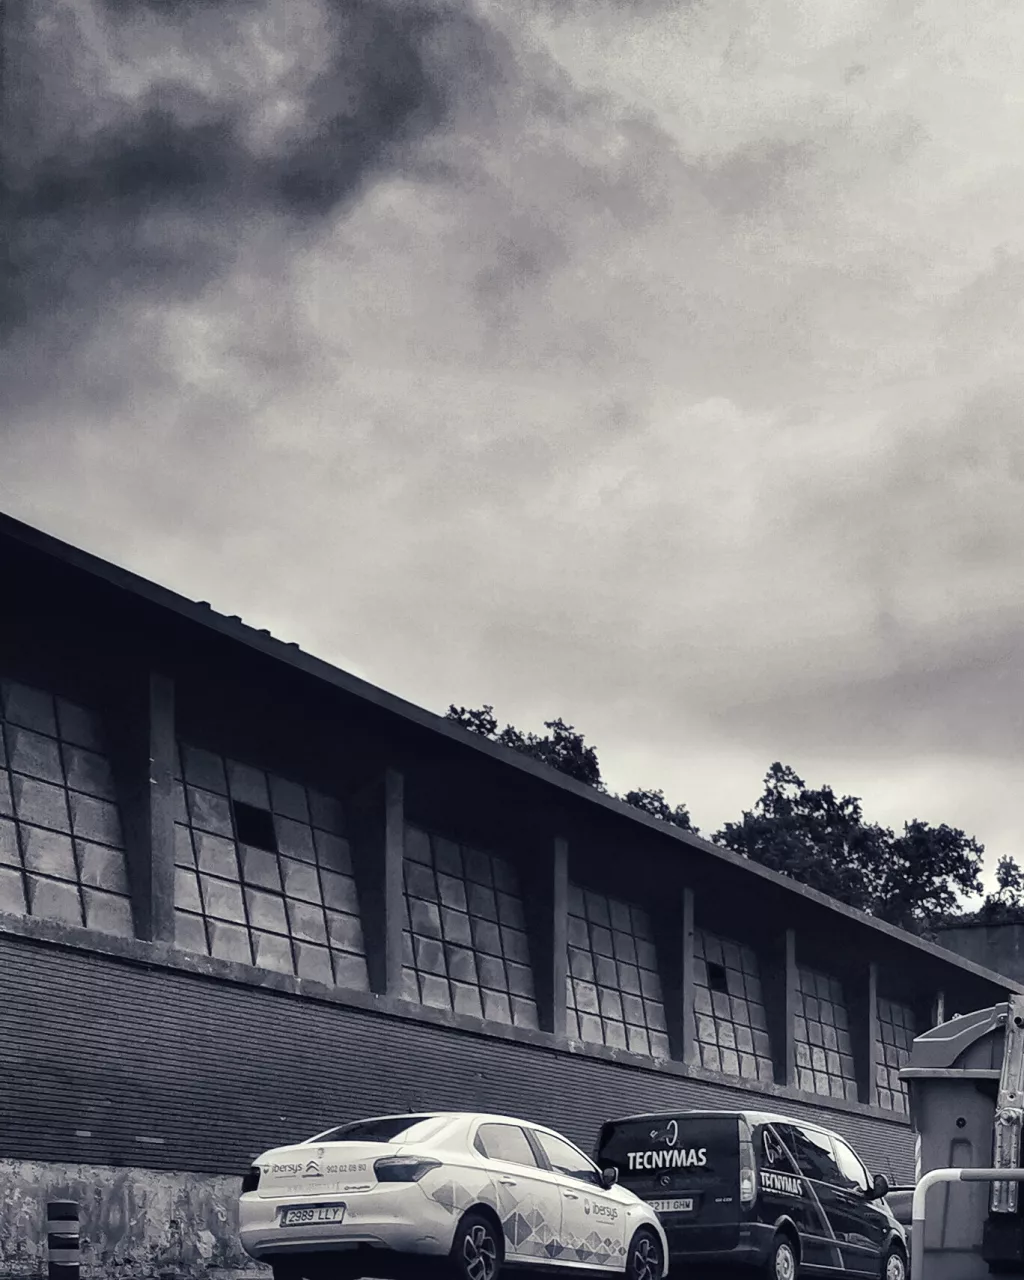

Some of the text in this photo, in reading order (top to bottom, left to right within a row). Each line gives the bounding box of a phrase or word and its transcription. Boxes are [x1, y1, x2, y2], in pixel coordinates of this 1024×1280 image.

[627, 1148, 707, 1170] TECNYMAS
[760, 1171, 803, 1195] TECNYMAS
[288, 1208, 340, 1222] 2989 LLY
